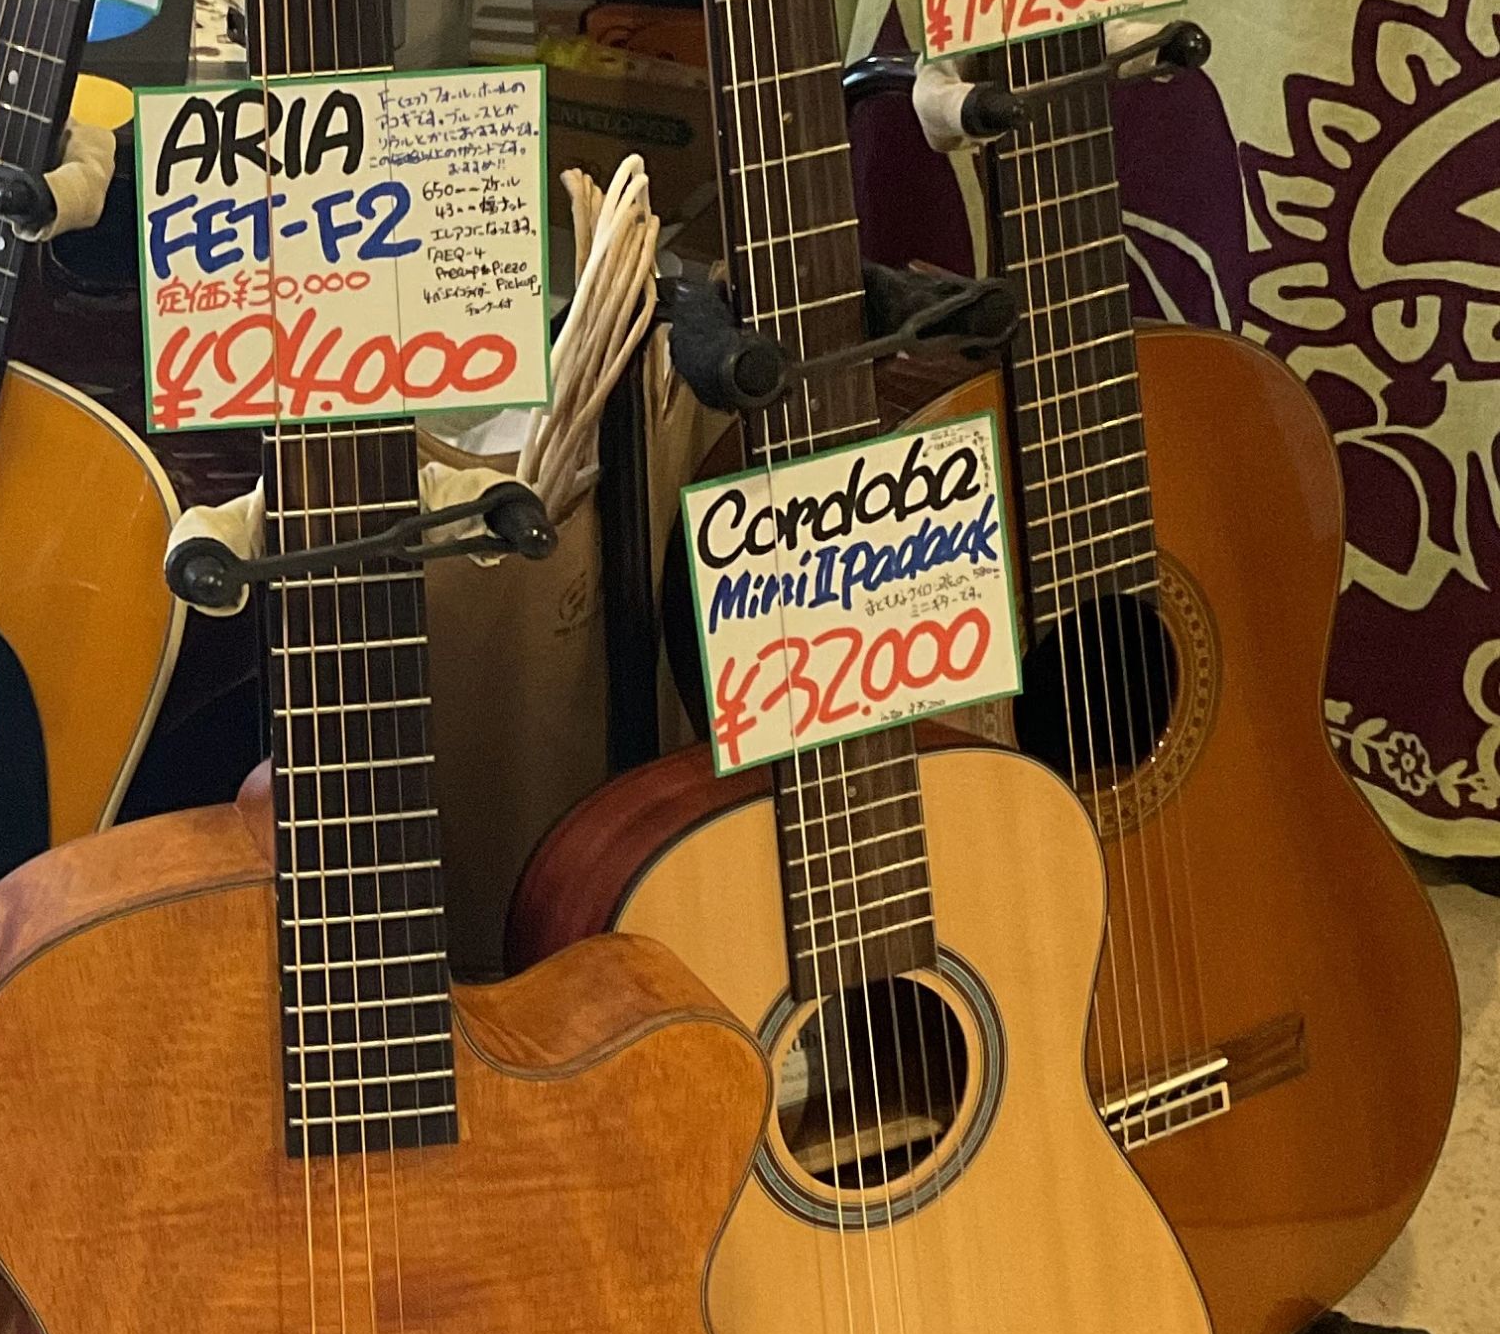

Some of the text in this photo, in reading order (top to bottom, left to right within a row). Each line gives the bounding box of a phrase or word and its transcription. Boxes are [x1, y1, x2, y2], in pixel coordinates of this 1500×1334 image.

[156, 89, 365, 196] ARIA
[148, 181, 422, 279] FET-F2
[698, 438, 981, 569] Cordoba
